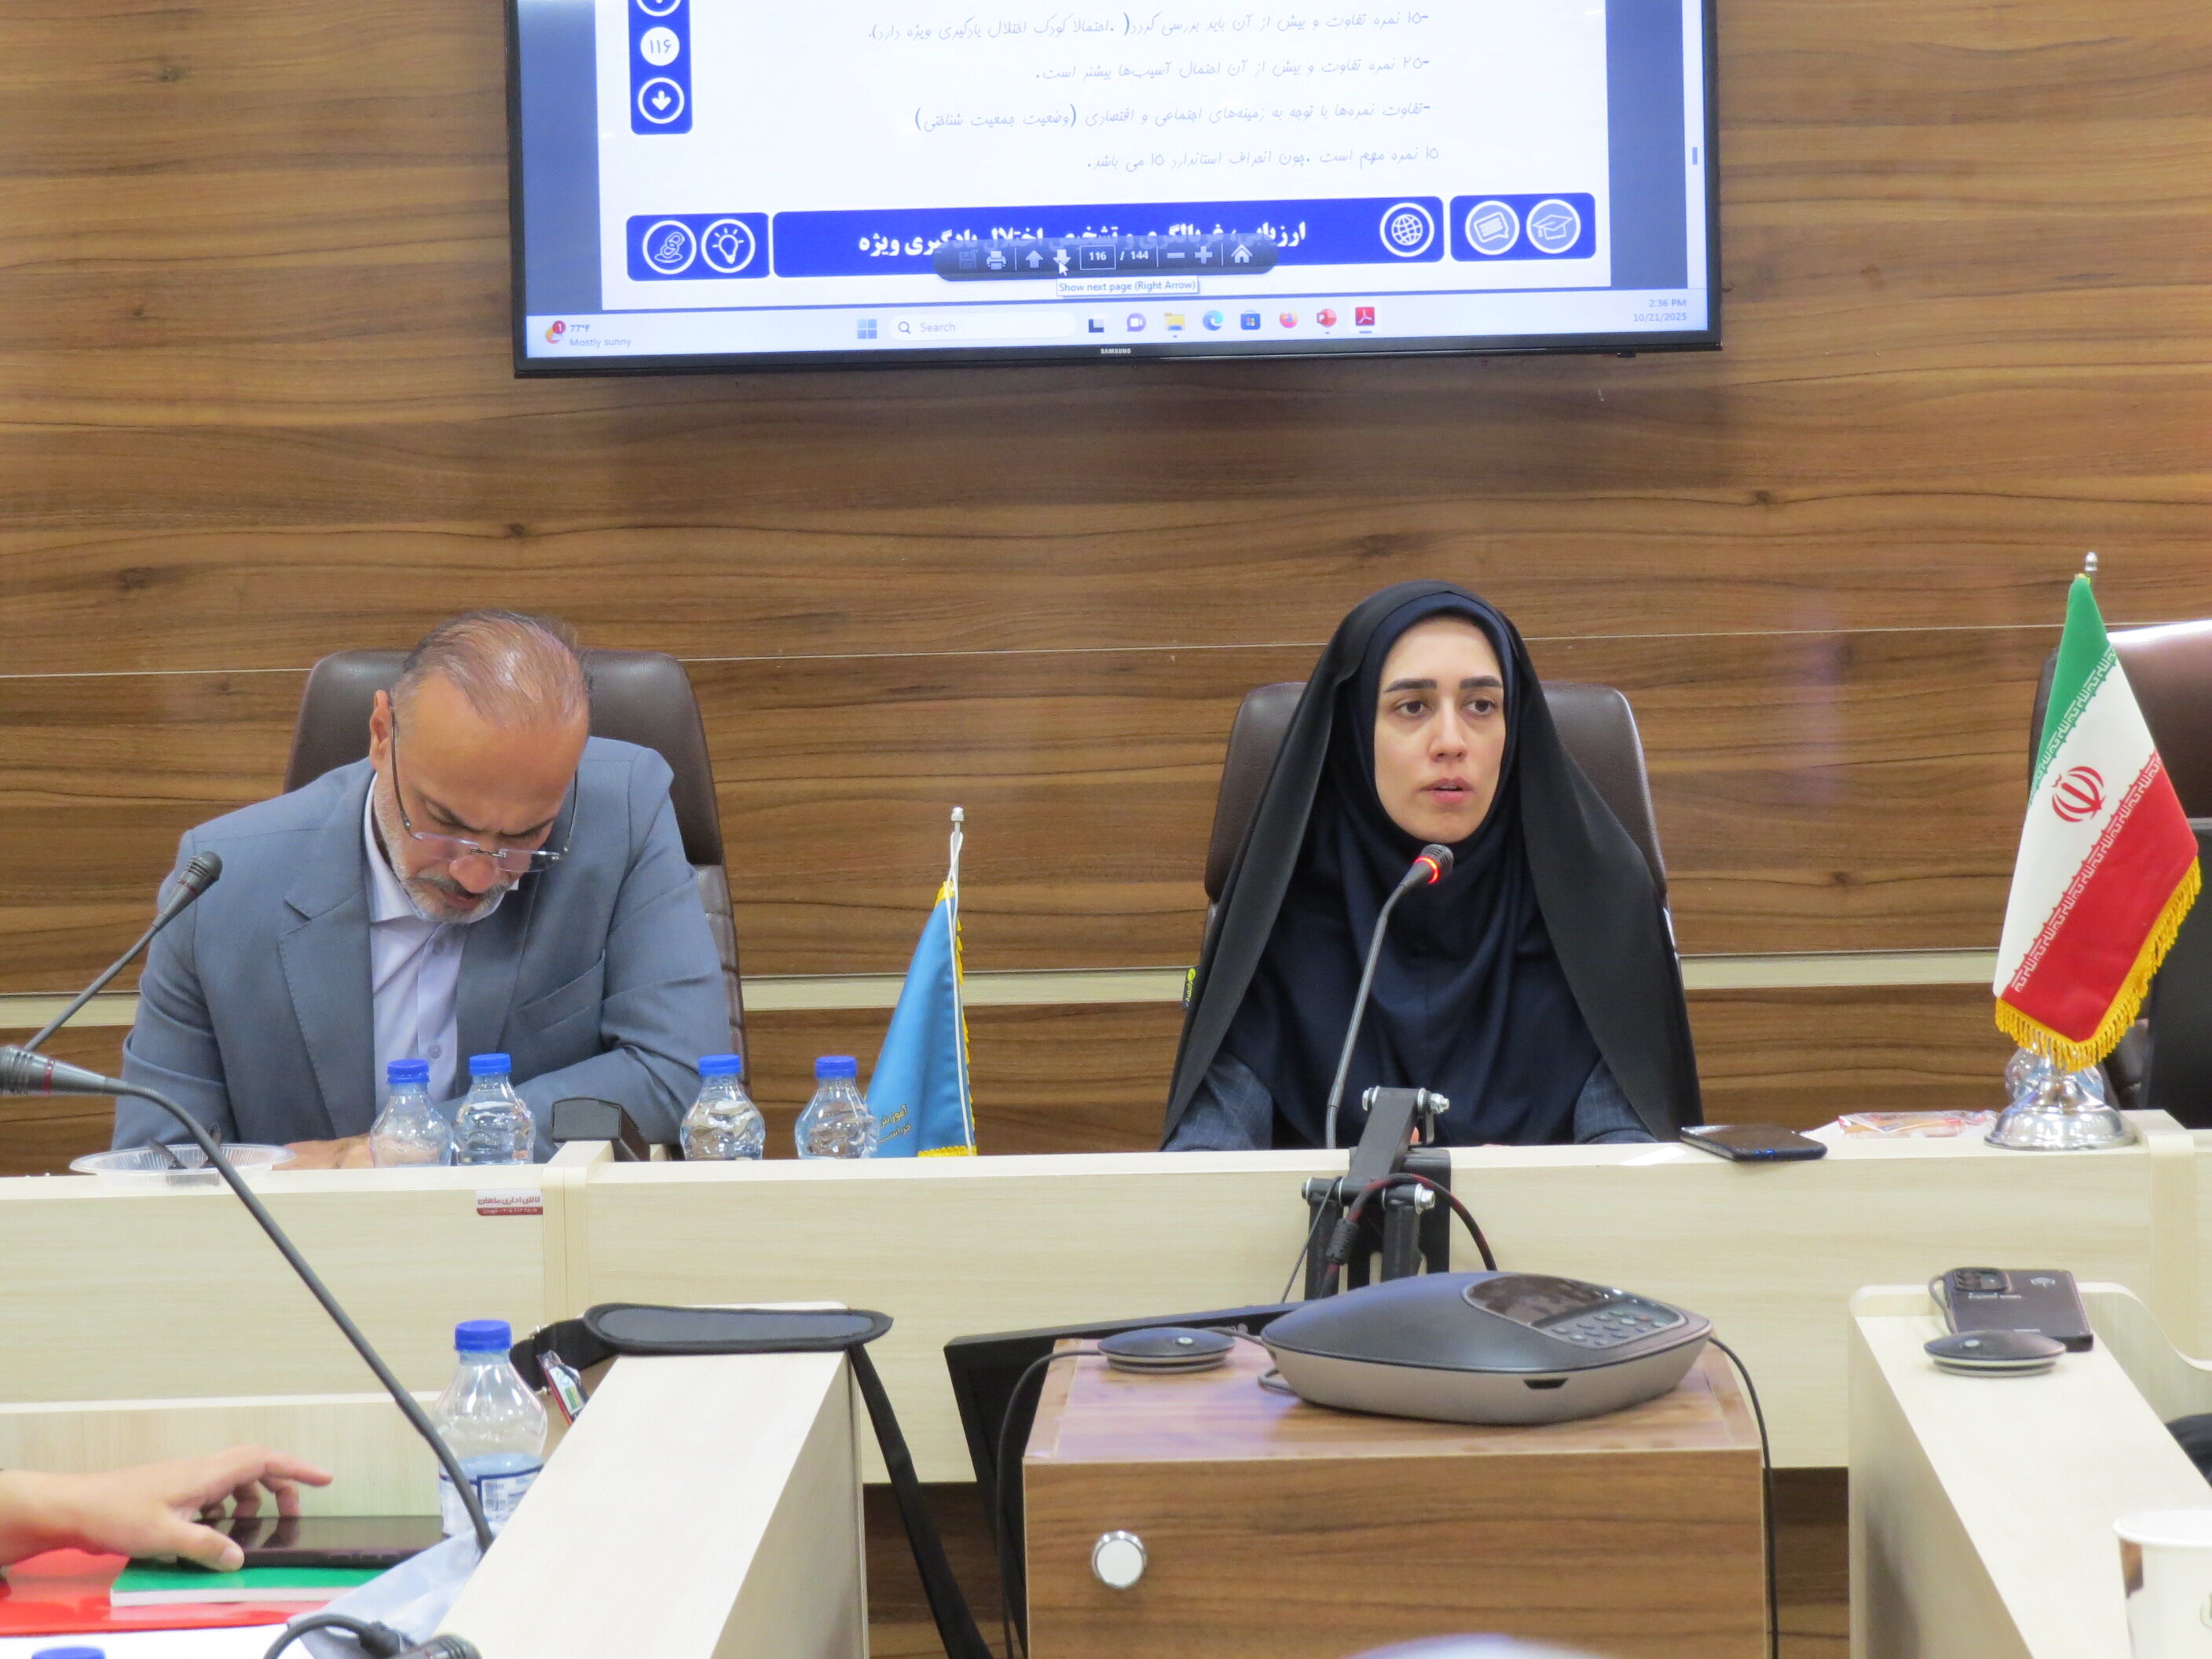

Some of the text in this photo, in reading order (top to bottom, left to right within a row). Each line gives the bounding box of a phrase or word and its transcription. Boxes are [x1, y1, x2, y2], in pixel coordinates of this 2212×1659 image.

[650, 38, 672, 54] ۱۱۶
[858, 233, 901, 258] ویژه
[1089, 251, 1108, 262] 116
[1130, 250, 1149, 261] 144
[1059, 280, 1196, 294] Show next page (Right Arrow)
[1649, 298, 1687, 308] 2:36 PM
[1633, 312, 1687, 322] 10/21/2025
[919, 321, 957, 333] Search
[569, 338, 632, 349] Mostly sunny
